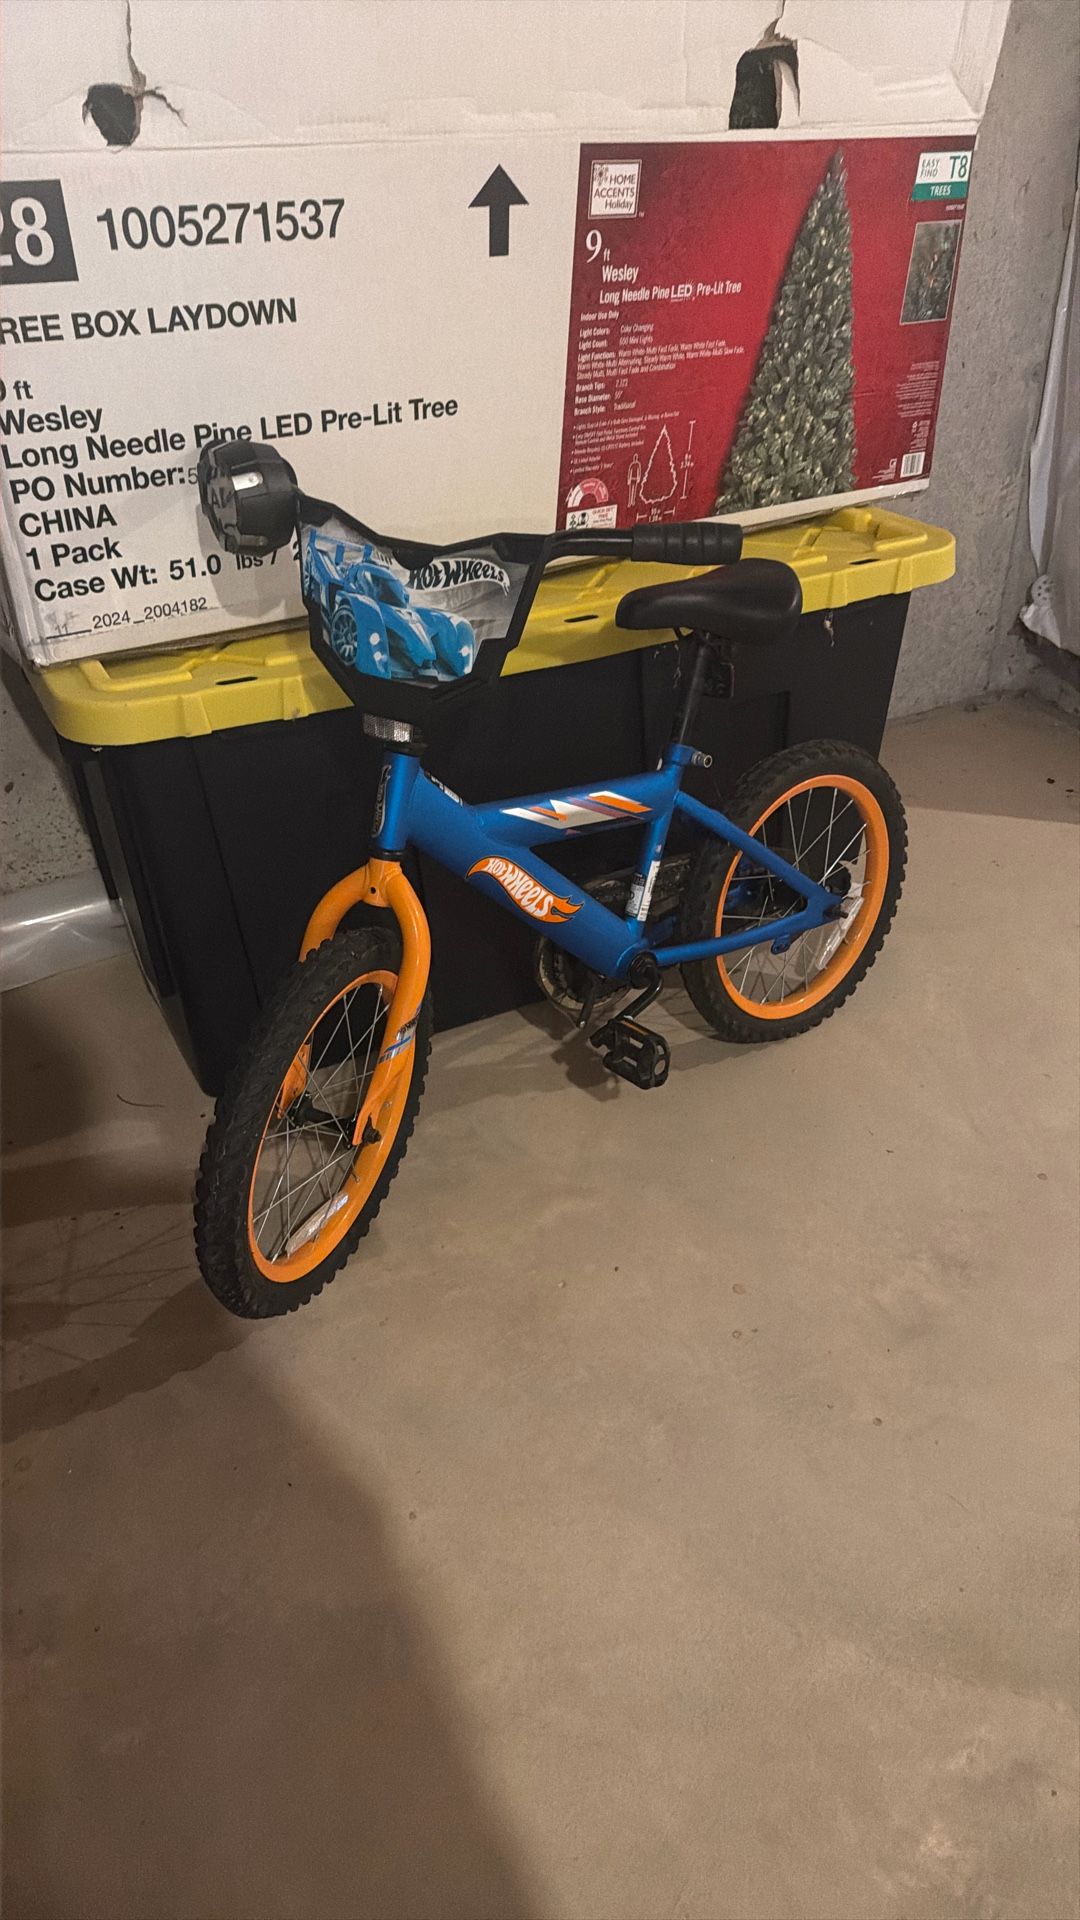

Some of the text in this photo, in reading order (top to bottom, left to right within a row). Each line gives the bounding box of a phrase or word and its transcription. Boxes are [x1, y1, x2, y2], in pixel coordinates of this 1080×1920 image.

[921, 159, 940, 168] EASY
[950, 155, 969, 179] T8
[609, 174, 636, 186] HOME
[930, 185, 951, 196] TREES
[593, 187, 635, 198] ACCENTS
[605, 199, 633, 212] Holiday
[97, 198, 345, 250] 1005271537
[585, 229, 610, 264] 9 ft
[602, 264, 639, 284] Wesley
[599, 280, 742, 306] Long Needle Pine LED Pre-Lit Tree
[71, 308, 141, 339] BOX
[147, 297, 298, 334] LAYDOWN
[580, 313, 598, 322] Indoor
[608, 310, 619, 321] Only
[579, 329, 592, 339] Light
[593, 327, 611, 337] Colors:
[578, 342, 592, 351] Light
[577, 353, 591, 364] Light
[13, 380, 34, 400] ft
[0, 404, 103, 436] Wesley
[1, 398, 459, 469] Long Needle Pine LED Pre-Lit Tree
[9, 475, 56, 504] PO
[63, 466, 186, 498] Number:
[19, 503, 118, 537] CHINA
[26, 537, 123, 571] 1 Pack
[35, 576, 106, 601] Case
[111, 564, 158, 589] Wt:
[169, 554, 222, 580] 51.0
